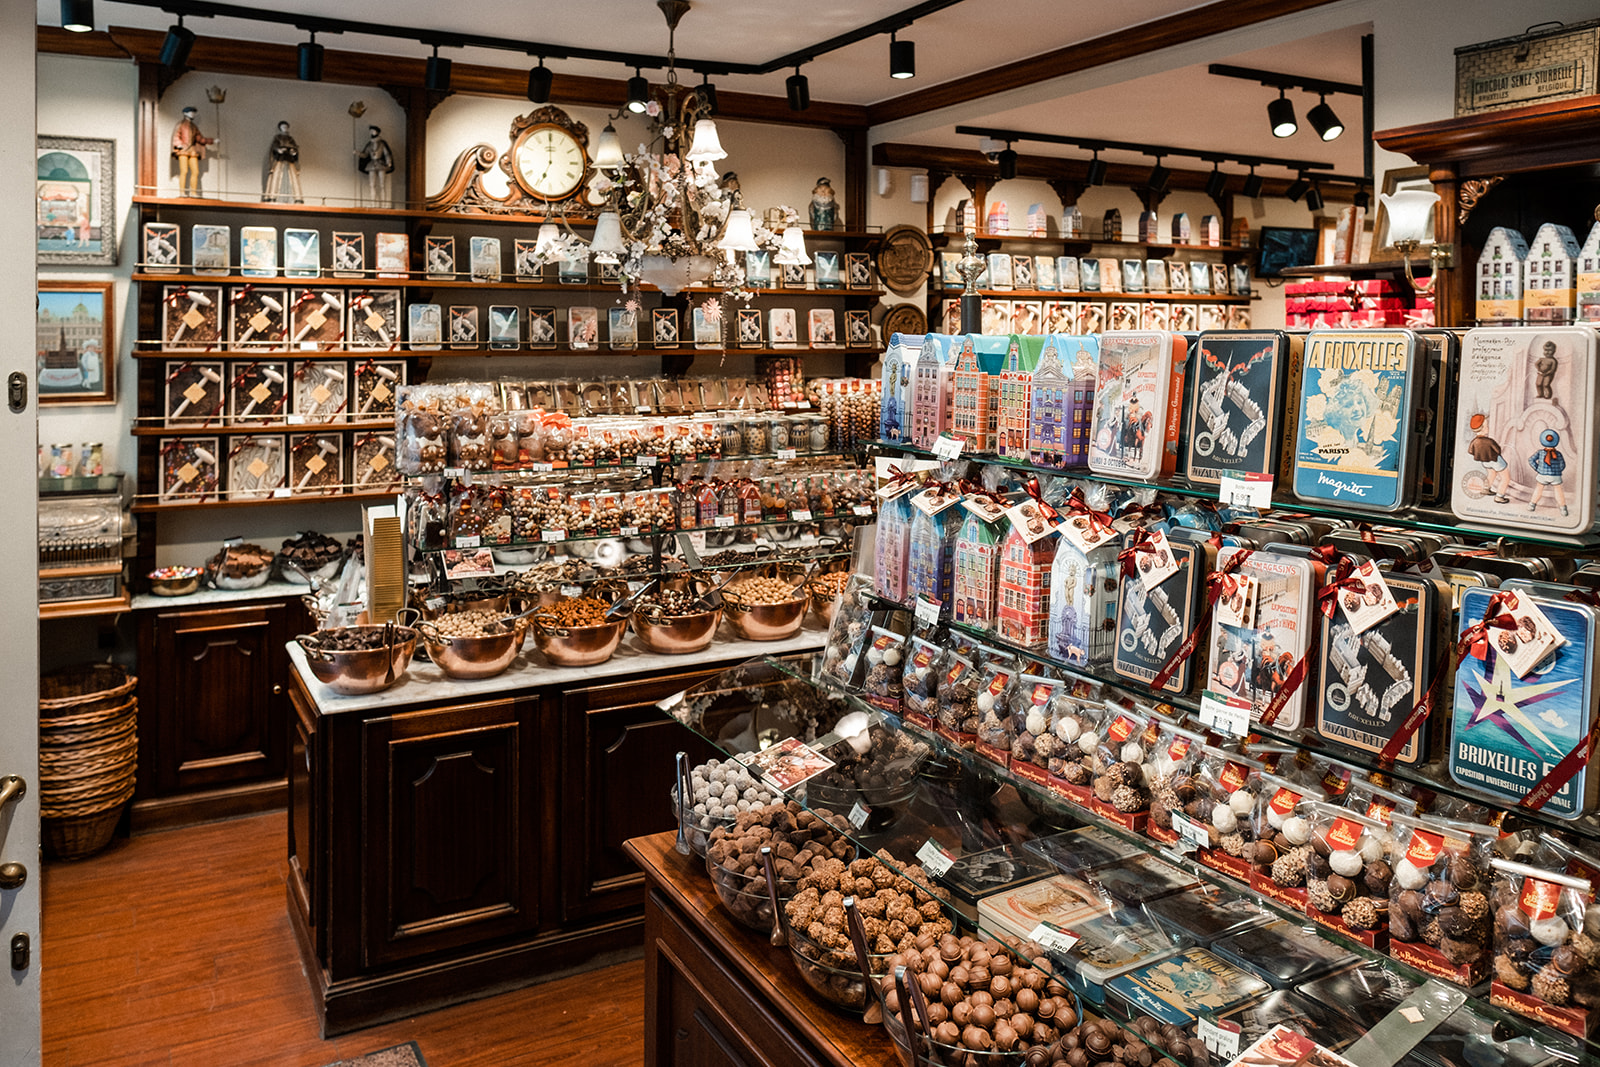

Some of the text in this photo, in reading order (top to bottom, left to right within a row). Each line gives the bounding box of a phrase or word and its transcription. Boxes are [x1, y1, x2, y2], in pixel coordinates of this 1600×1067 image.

[1475, 77, 1508, 94] CHOCOLAT
[1537, 81, 1568, 93] BELGIQUE
[1309, 341, 1404, 371] A BRUXELLES
[1256, 562, 1297, 575] MAGASINS
[1348, 711, 1386, 727] BRUXELLES
[1322, 721, 1358, 741] JOYAUX
[1458, 742, 1537, 781] BRUXELLES
[1455, 765, 1485, 781] EXPOSITION
[1485, 773, 1518, 792] UNIVERSELLE
[1519, 785, 1526, 795] ET
[1535, 1005, 1571, 1026] Gourmande
